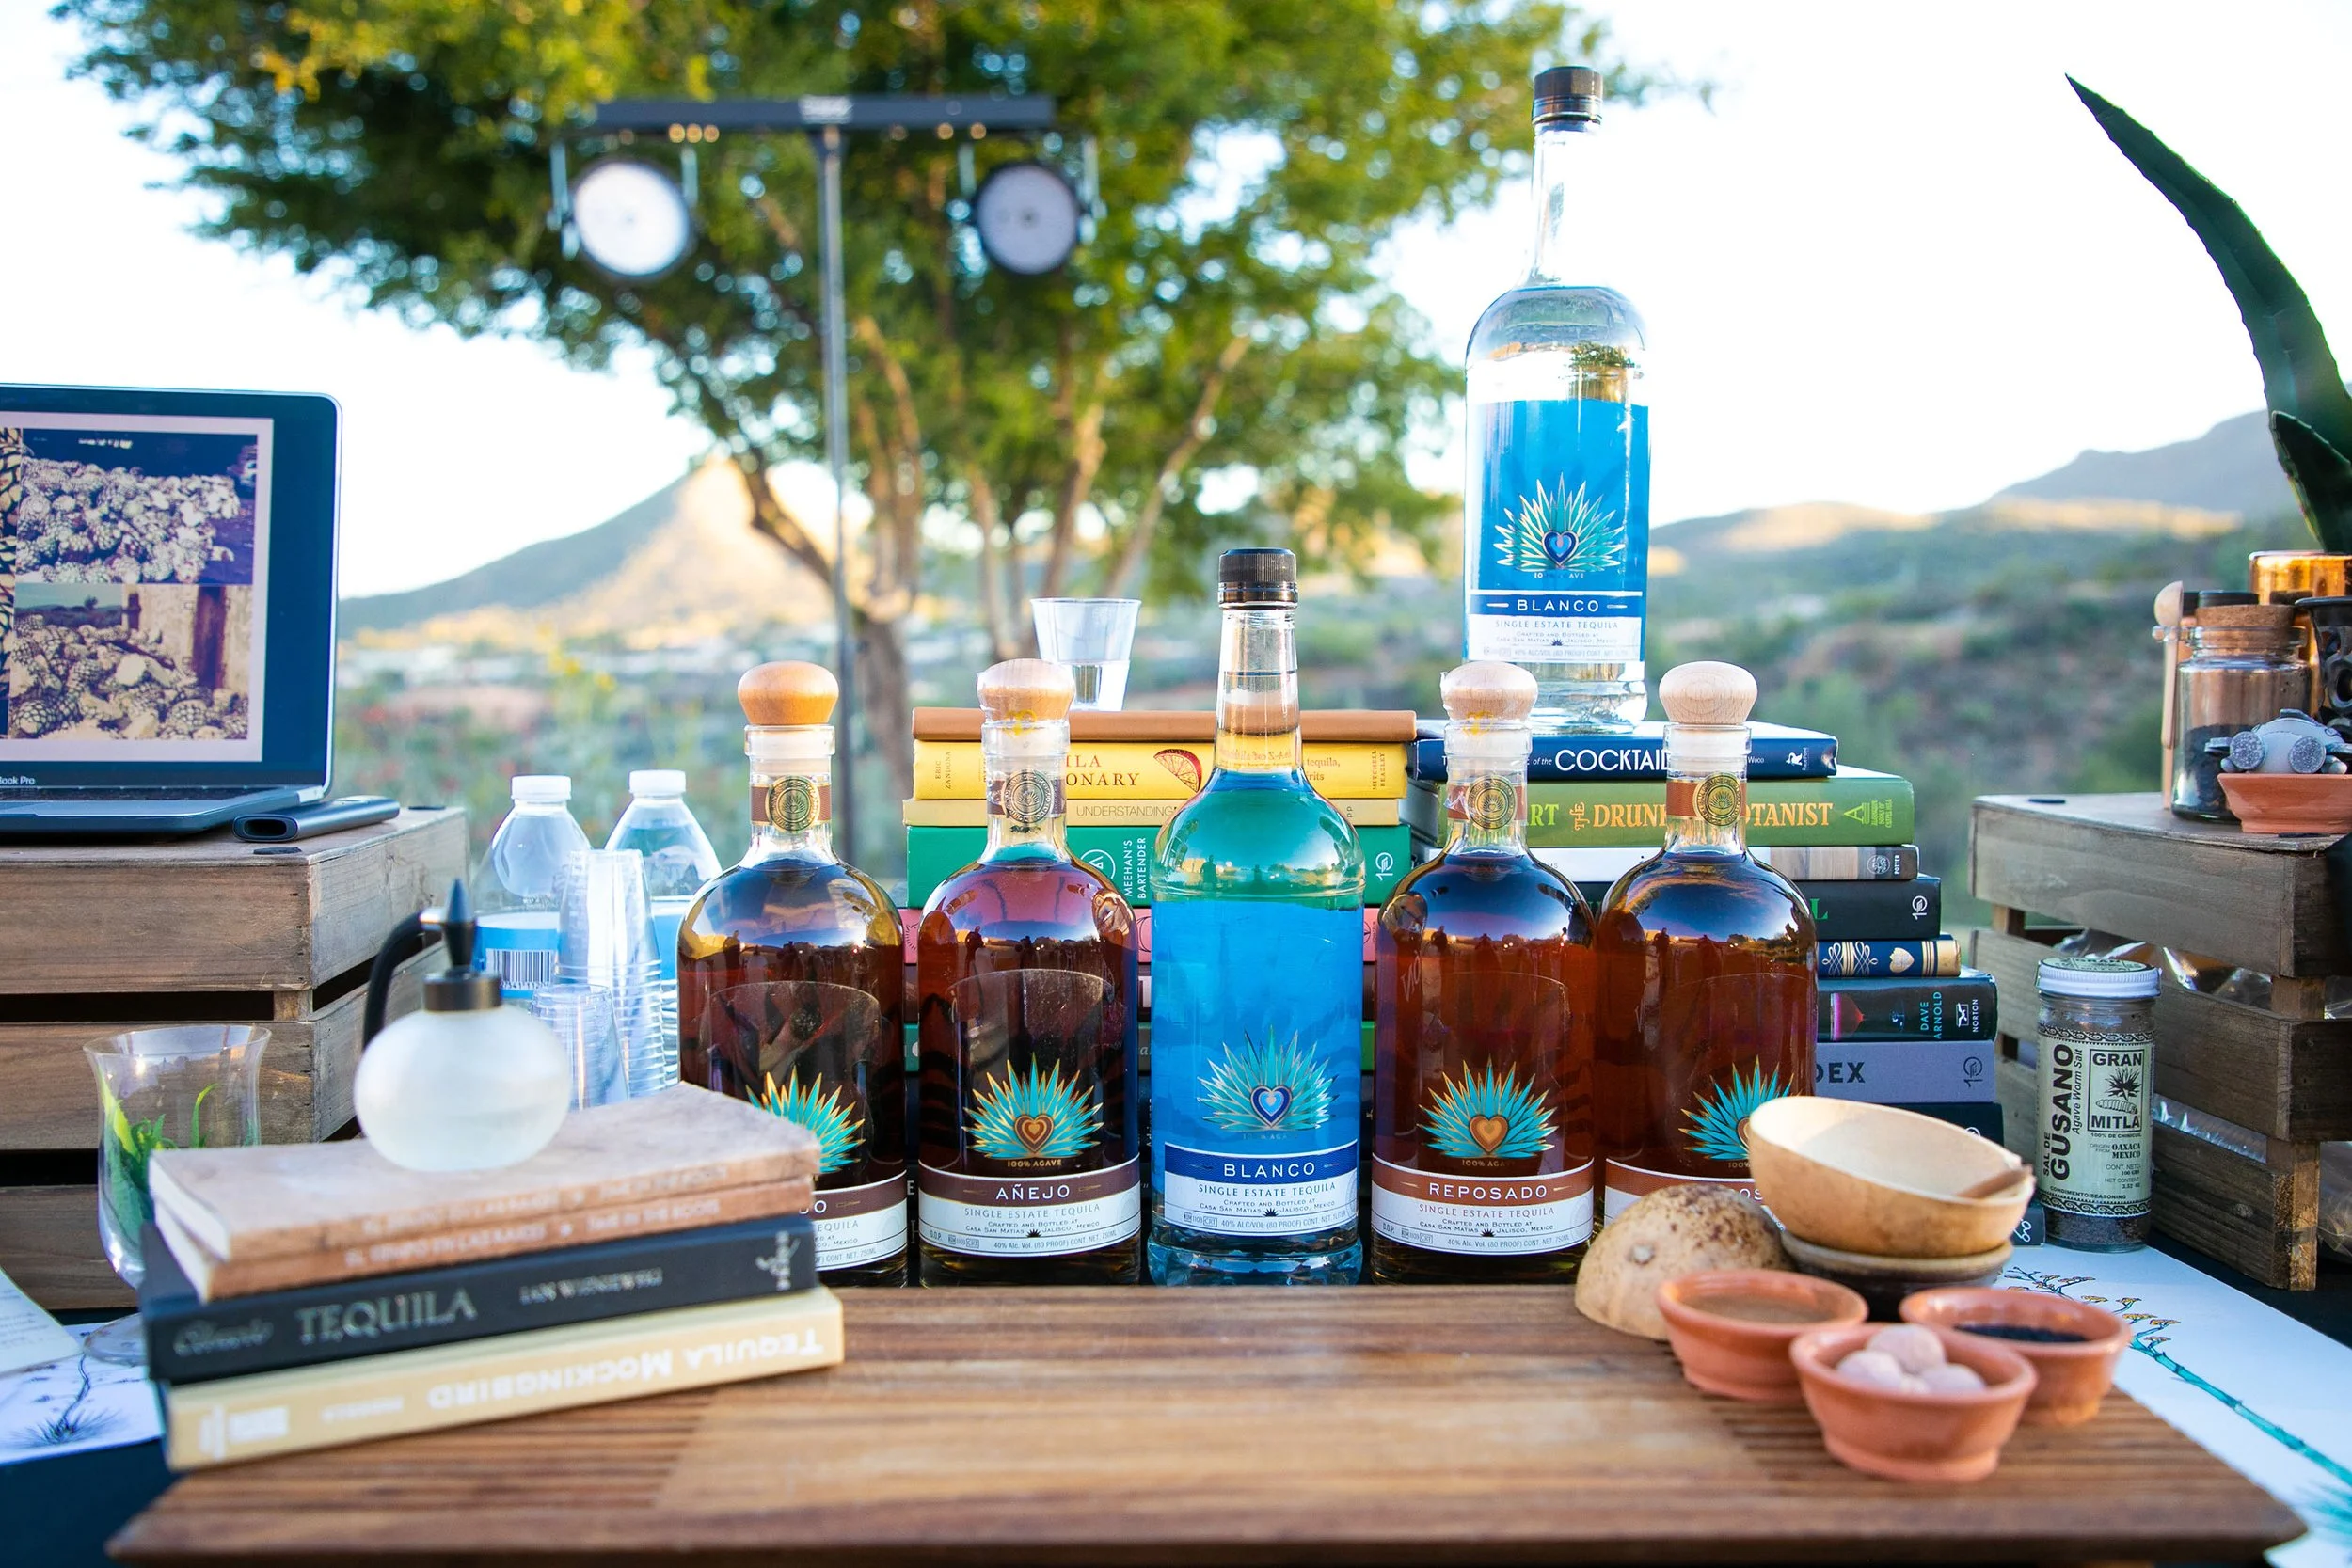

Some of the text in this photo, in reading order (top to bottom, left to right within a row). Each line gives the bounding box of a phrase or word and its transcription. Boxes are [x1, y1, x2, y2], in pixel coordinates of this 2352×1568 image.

[1517, 599, 1599, 612] BLANCO
[1534, 620, 1572, 629] ESTATE
[1577, 621, 1619, 629] TEQUILA
[1533, 757, 1541, 766] of
[1541, 757, 1553, 766] the
[20, 776, 36, 785] Pro
[1076, 806, 1174, 817] UNDERSTANDING
[1123, 840, 1133, 896] MEEHAN'S
[1137, 837, 1146, 899] BARTENDER
[1920, 1000, 1929, 1031] DAVE
[1933, 991, 1942, 1040] ARNOLD
[2092, 1053, 2142, 1066] GRAN
[2072, 1049, 2083, 1135] Agave Worm Salt
[2050, 1044, 2074, 1180] GUSANO
[2091, 1115, 2140, 1129] MITLA
[2044, 1132, 2051, 1148] DE
[2112, 1142, 2141, 1151] OAXACA
[1033, 1158, 1062, 1167] AGAVE
[1224, 1162, 1316, 1178] BLANCO
[996, 1183, 1070, 1201] AÑEJO
[1198, 1182, 1336, 1197] SINGLE ESTATE TEQUILA
[1429, 1182, 1547, 1200] REPOSADO
[964, 1204, 1101, 1219] SINGLE ESTATE TEQUILA
[1419, 1204, 1555, 1219] SINGLE ESTATE TEQUILA
[1221, 1220, 1236, 1228] 40%
[1279, 1220, 1302, 1228] PROOF)
[1419, 1220, 1436, 1229] CASA
[1442, 1218, 1473, 1227] CRAFTED
[1447, 1237, 1461, 1246] 40%
[295, 1287, 478, 1346] TEQUILA
[682, 1327, 825, 1369] TEQUILA
[427, 1347, 674, 1411] MOCKINGBIRD
